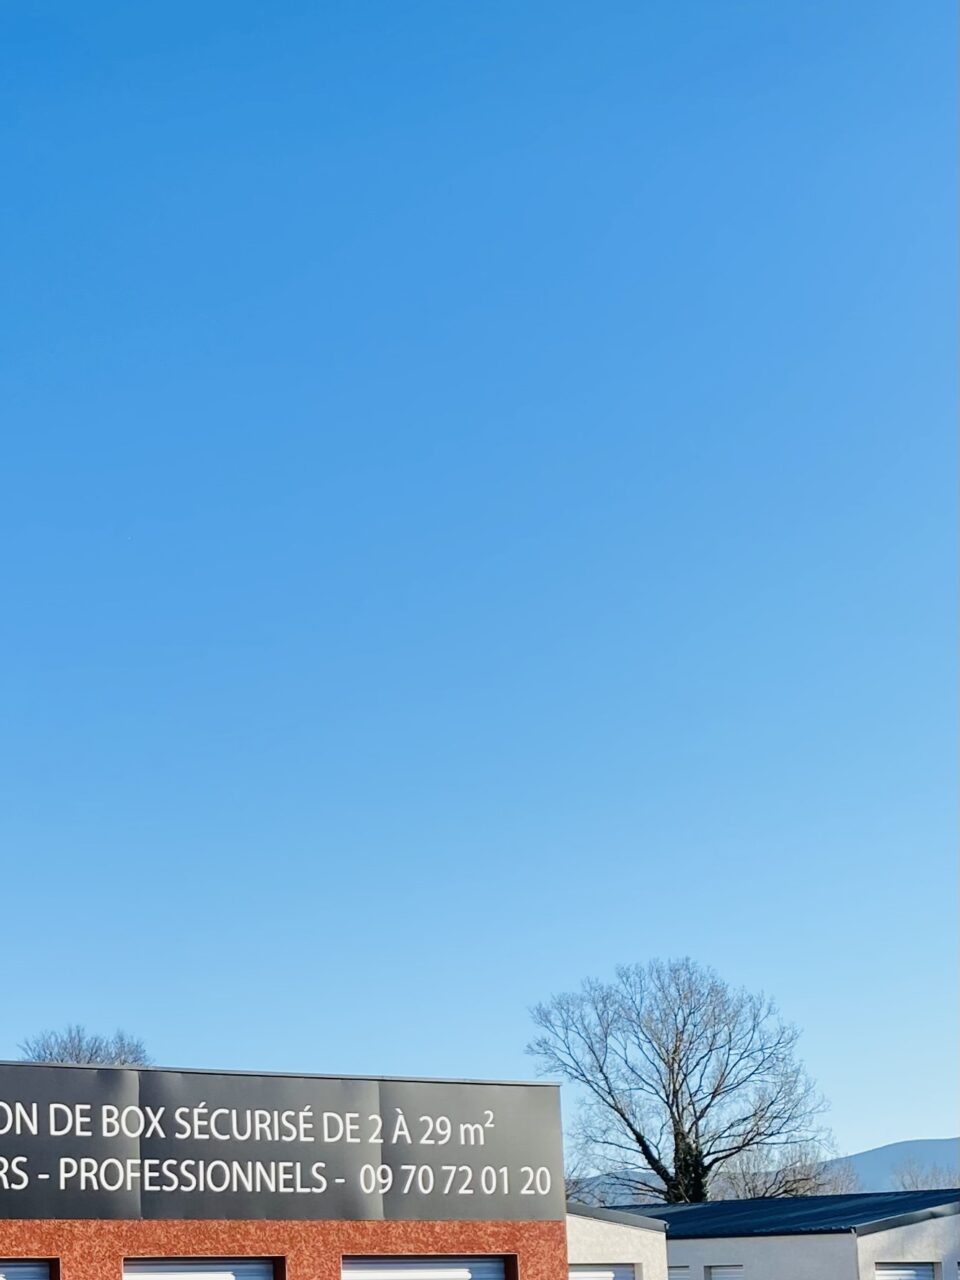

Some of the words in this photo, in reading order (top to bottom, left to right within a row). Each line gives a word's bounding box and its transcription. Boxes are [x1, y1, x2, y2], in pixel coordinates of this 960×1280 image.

[49, 1103, 93, 1137] DE
[101, 1104, 166, 1139] BOX
[174, 1101, 315, 1142] SÉCURISÉ
[322, 1112, 361, 1144] DE
[368, 1114, 384, 1144] 2
[392, 1108, 412, 1144] À
[419, 1115, 452, 1145] 29
[459, 1110, 495, 1146] m²
[59, 1157, 328, 1194] PROFESSIONNELS
[359, 1163, 393, 1195] 09
[400, 1165, 434, 1195] 70
[441, 1165, 474, 1195] 72
[481, 1165, 509, 1195] 01
[520, 1166, 551, 1196] 20
